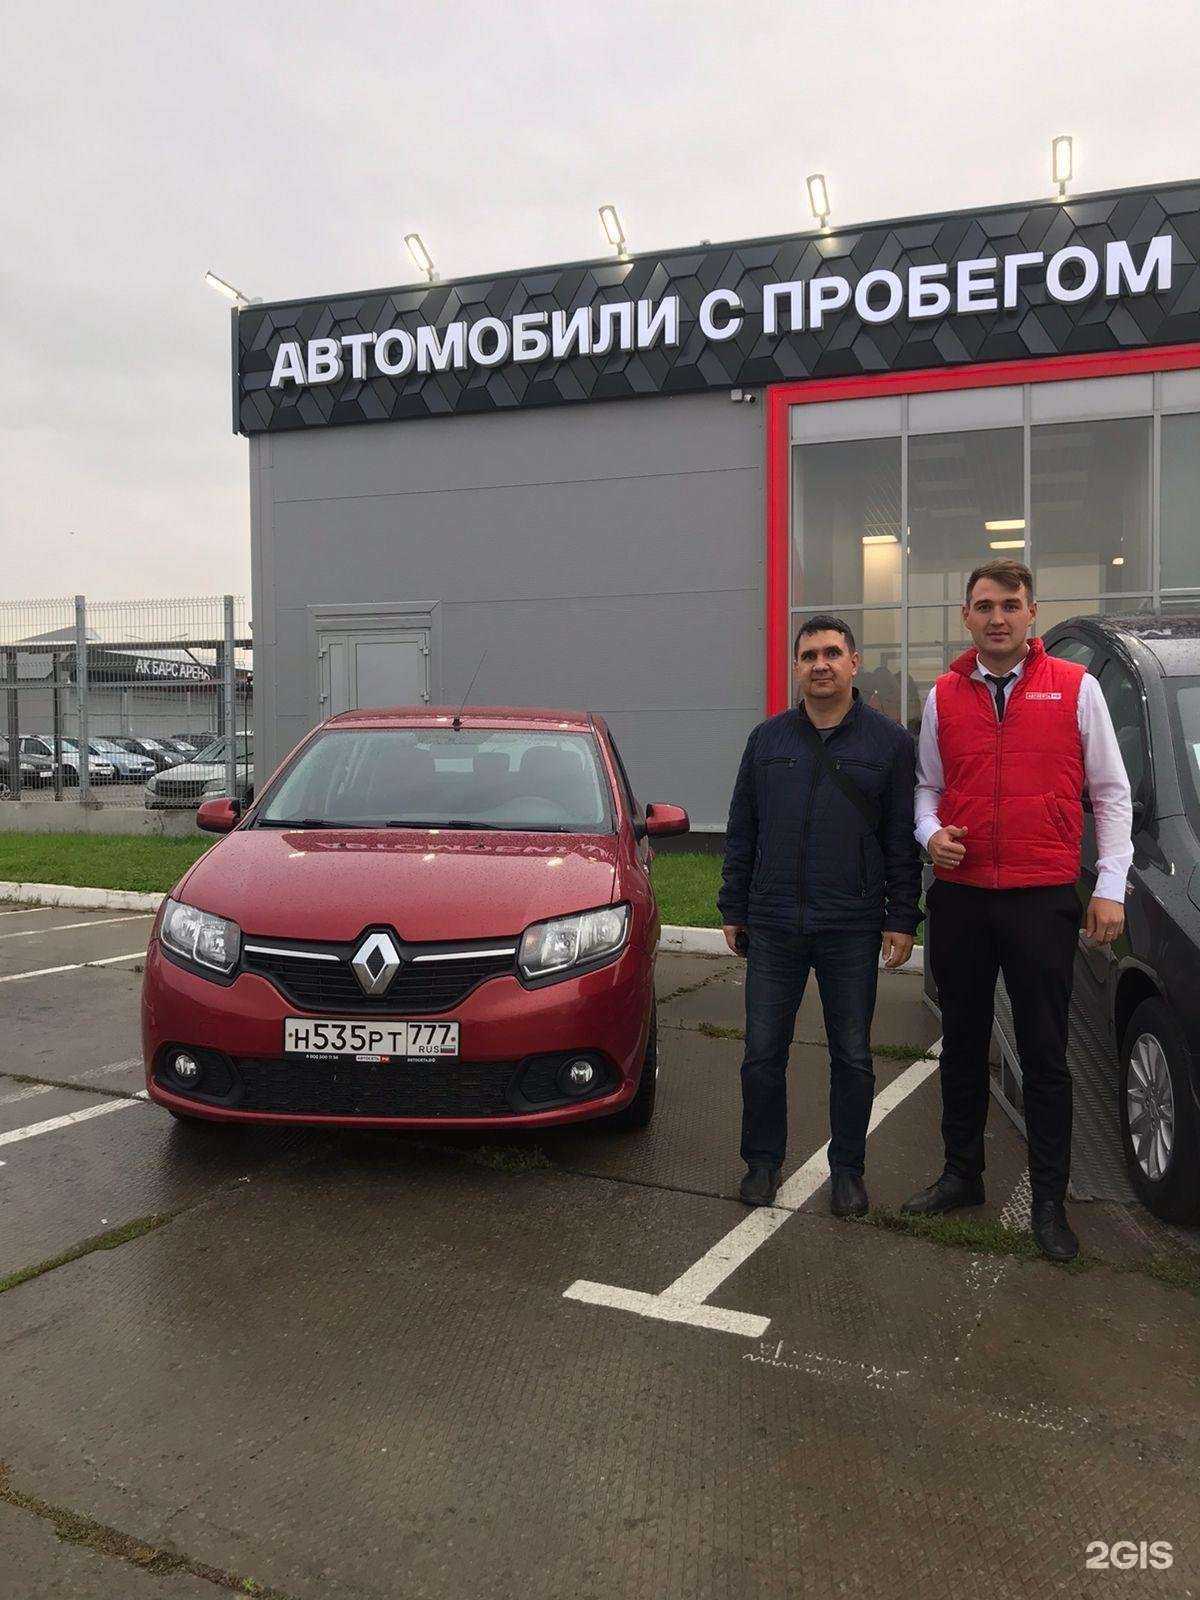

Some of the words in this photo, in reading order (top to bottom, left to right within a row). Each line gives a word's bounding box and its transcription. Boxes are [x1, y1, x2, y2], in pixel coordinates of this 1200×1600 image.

[270, 295, 680, 389] АВТОМОБИЛИ
[700, 288, 744, 341] С
[762, 234, 1173, 335] ПРОБЕГОМ
[294, 1023, 402, 1052] Н535РТ
[409, 1024, 451, 1045] 777
[418, 1045, 440, 1054] RUS
